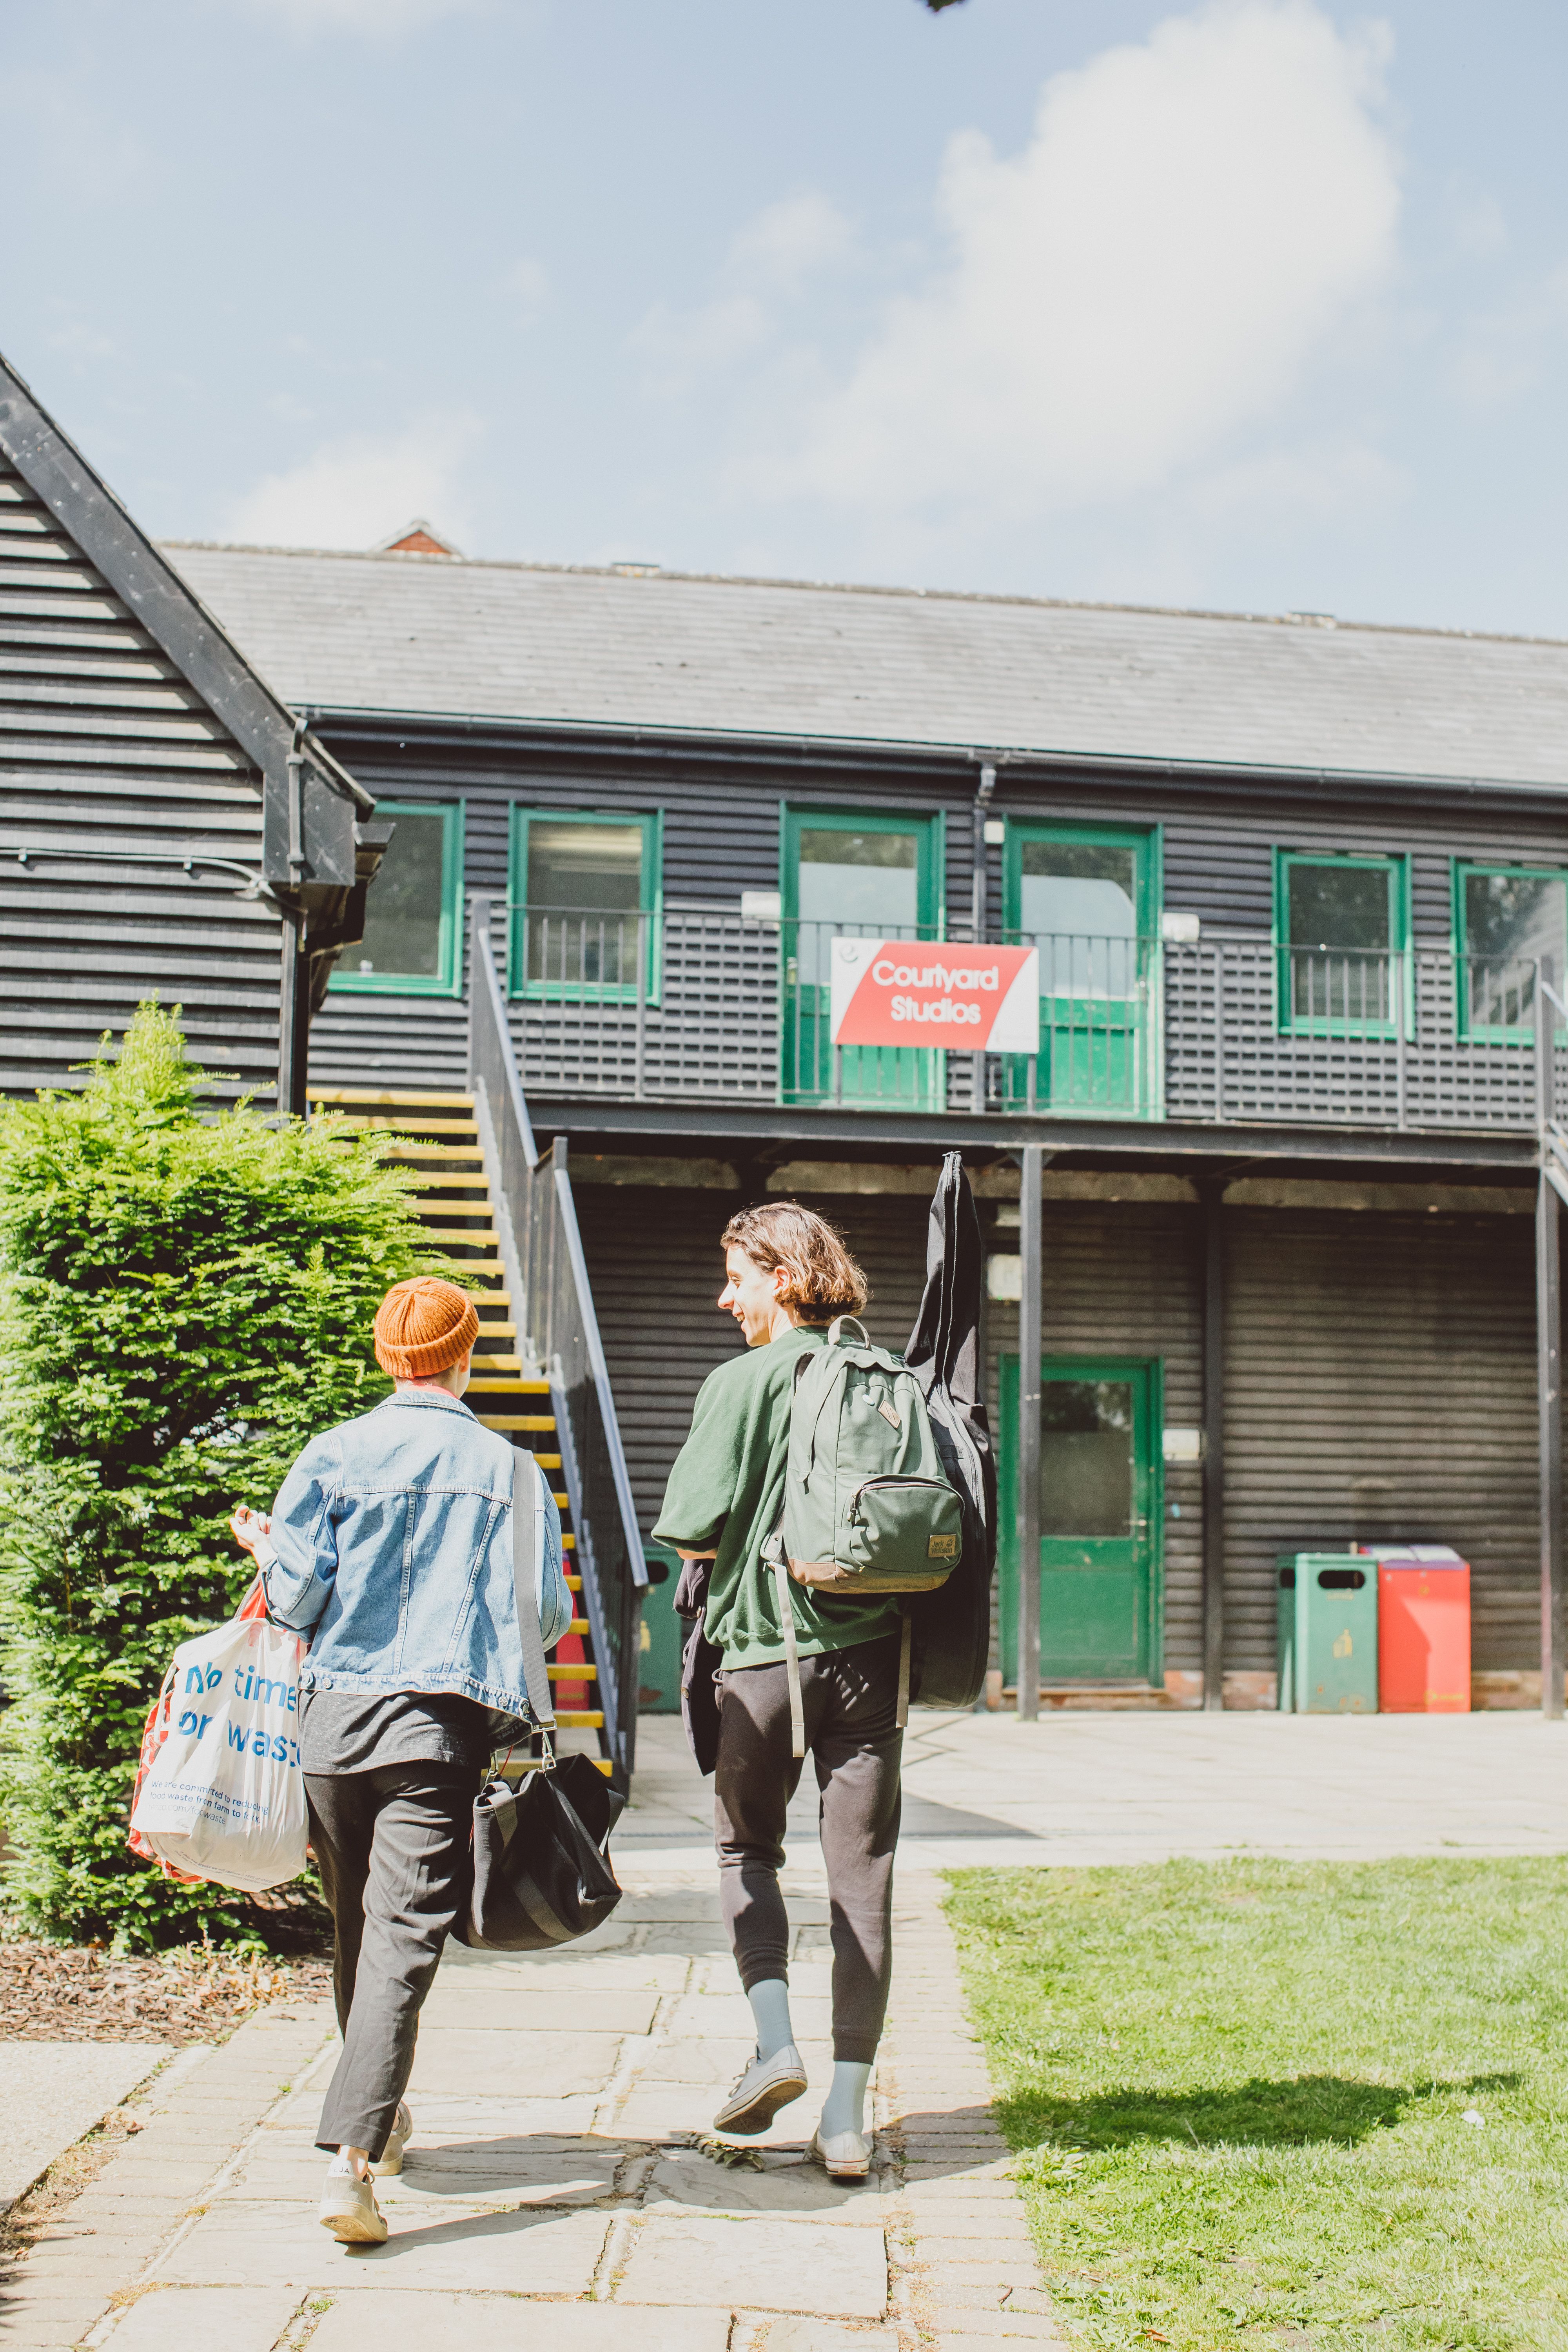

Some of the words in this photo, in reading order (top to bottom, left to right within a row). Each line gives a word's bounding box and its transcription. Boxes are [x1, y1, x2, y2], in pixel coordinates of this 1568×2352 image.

[872, 960, 999, 993] Courtyard
[891, 995, 981, 1024] Studios
[185, 1662, 223, 1694] No
[235, 1665, 296, 1712] time
[179, 1711, 214, 1740] or
[228, 1719, 300, 1767] was
[168, 1793, 193, 1802] waste
[214, 1801, 229, 1815] farm
[232, 1809, 241, 1818] to
[180, 1784, 223, 1799] commited
[225, 1794, 230, 1803] to
[232, 1799, 269, 1815] reducing
